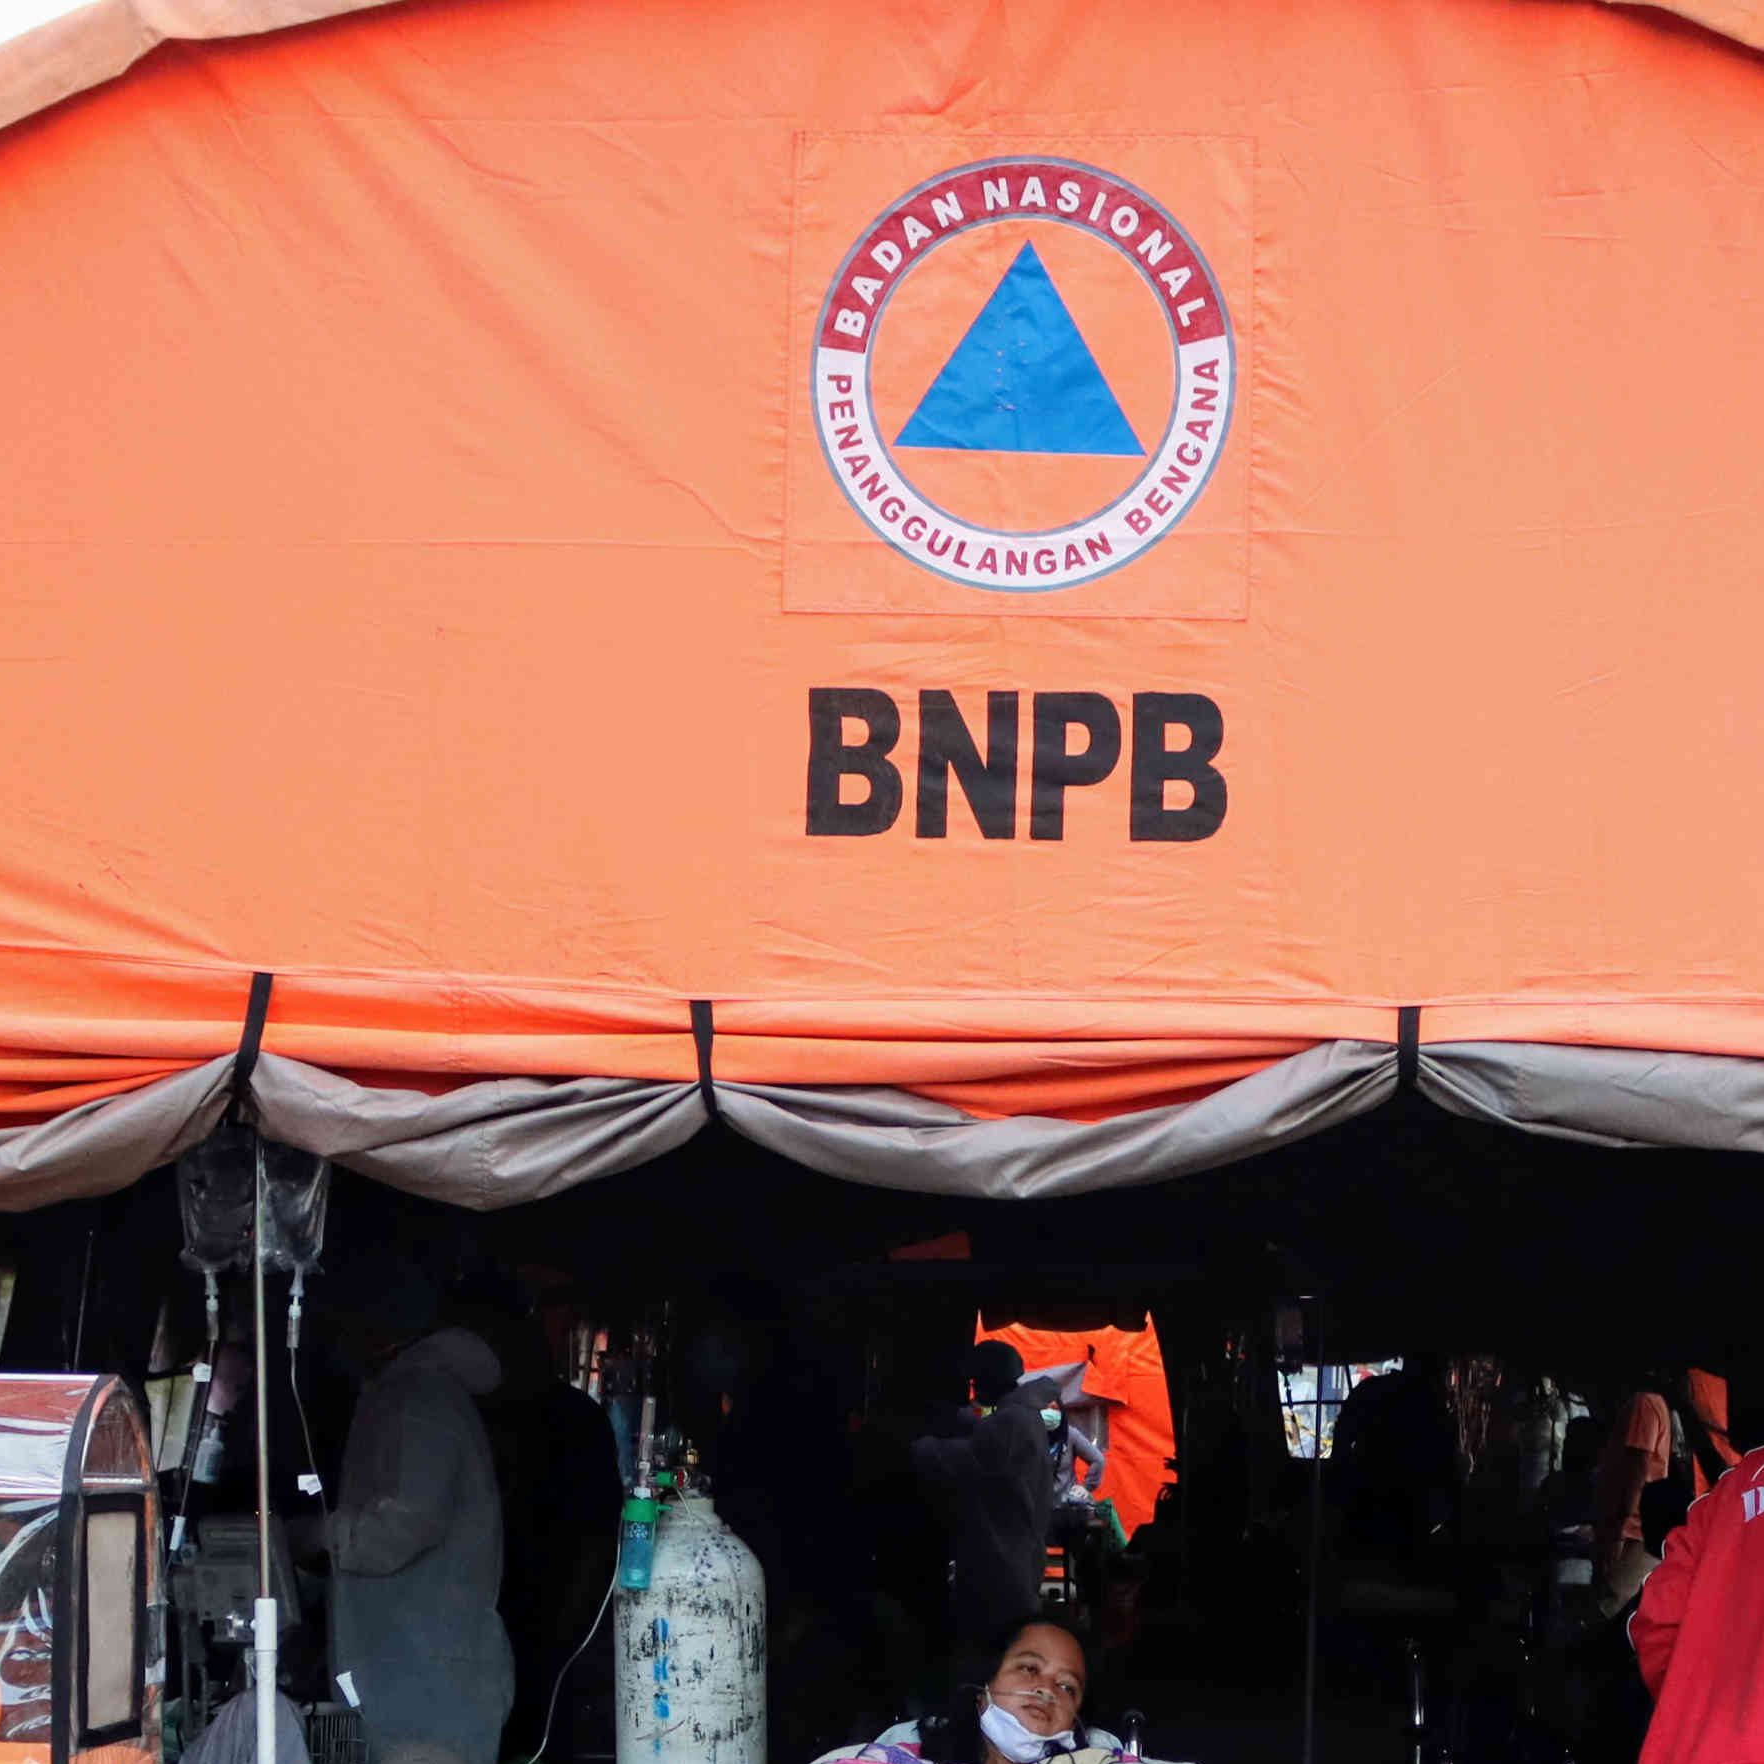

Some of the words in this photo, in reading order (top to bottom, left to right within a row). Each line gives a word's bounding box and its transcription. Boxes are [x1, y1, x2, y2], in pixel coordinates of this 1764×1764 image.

[834, 190, 964, 338] BADAN
[982, 177, 1209, 328] NASIONAL
[826, 372, 1113, 578] PENANGGULANGAN
[1123, 357, 1220, 538] BENCANA
[805, 687, 1229, 843] BNPB
